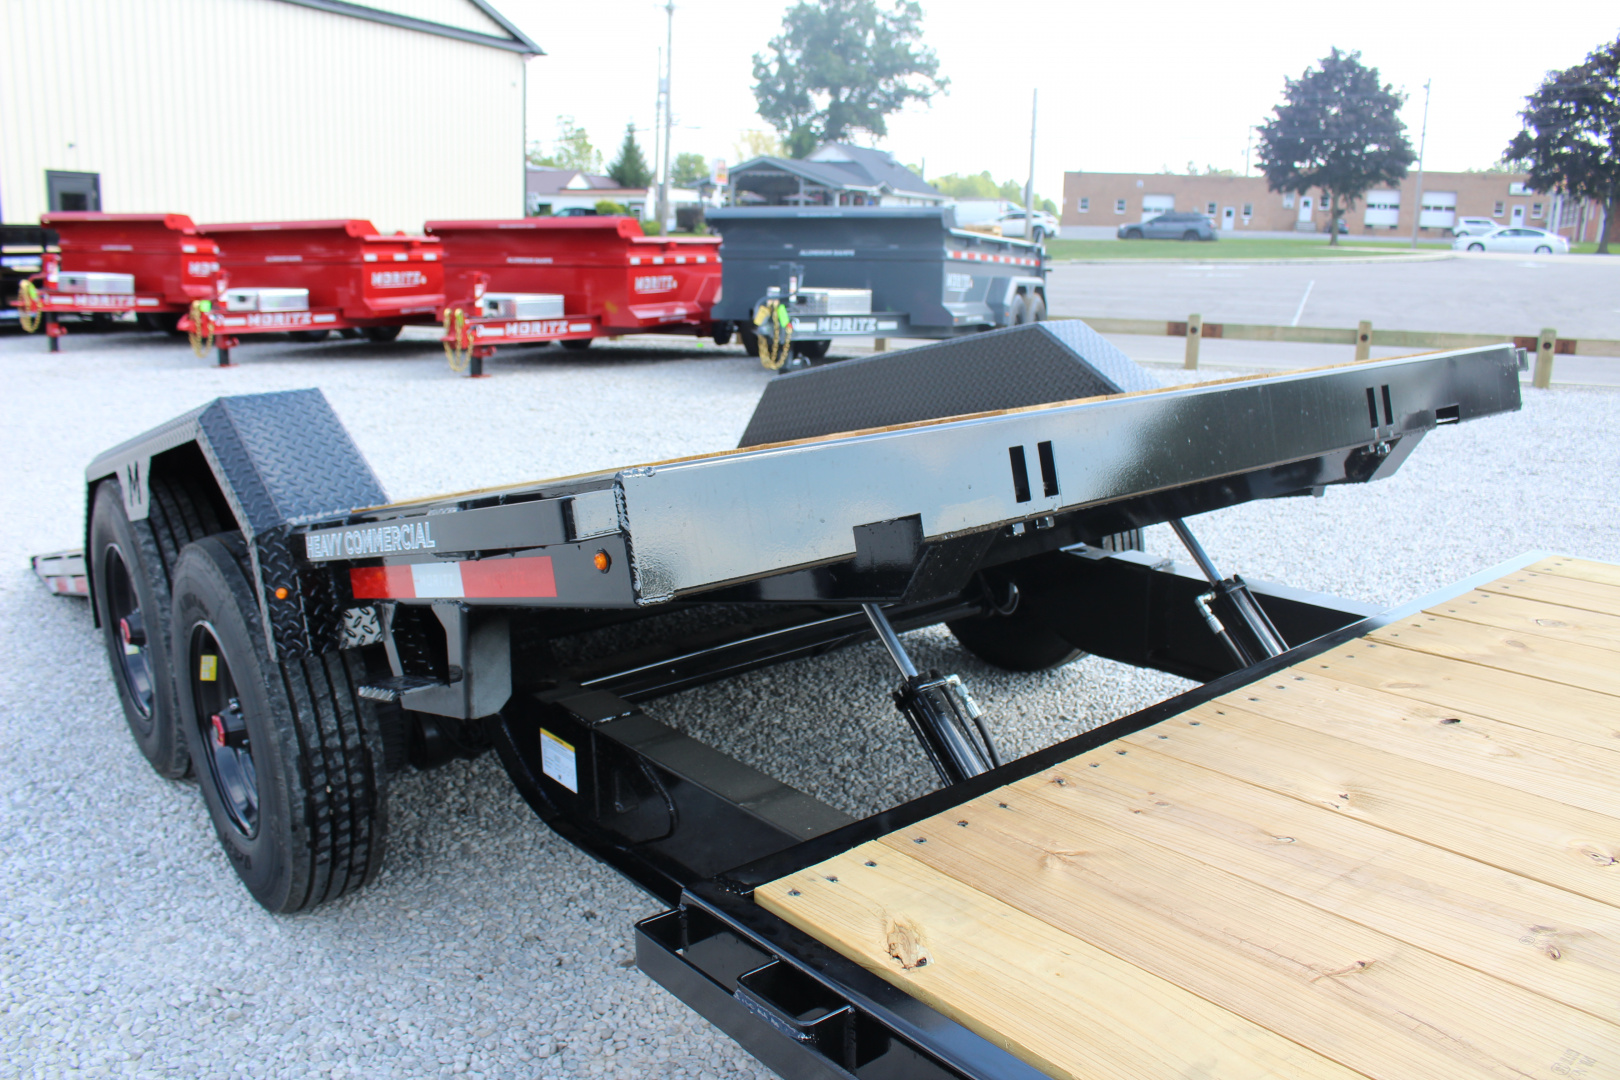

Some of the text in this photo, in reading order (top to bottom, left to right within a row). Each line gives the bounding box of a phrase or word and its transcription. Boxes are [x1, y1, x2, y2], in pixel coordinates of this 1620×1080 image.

[371, 271, 421, 286] MORITZ
[634, 275, 674, 291] MORITZ
[74, 295, 136, 307] MORITZ
[247, 312, 312, 326] MORITZ
[817, 317, 877, 332] MORITZ
[505, 320, 569, 336] MORITZ
[305, 521, 435, 558] HEAVY COMMERCIAL
